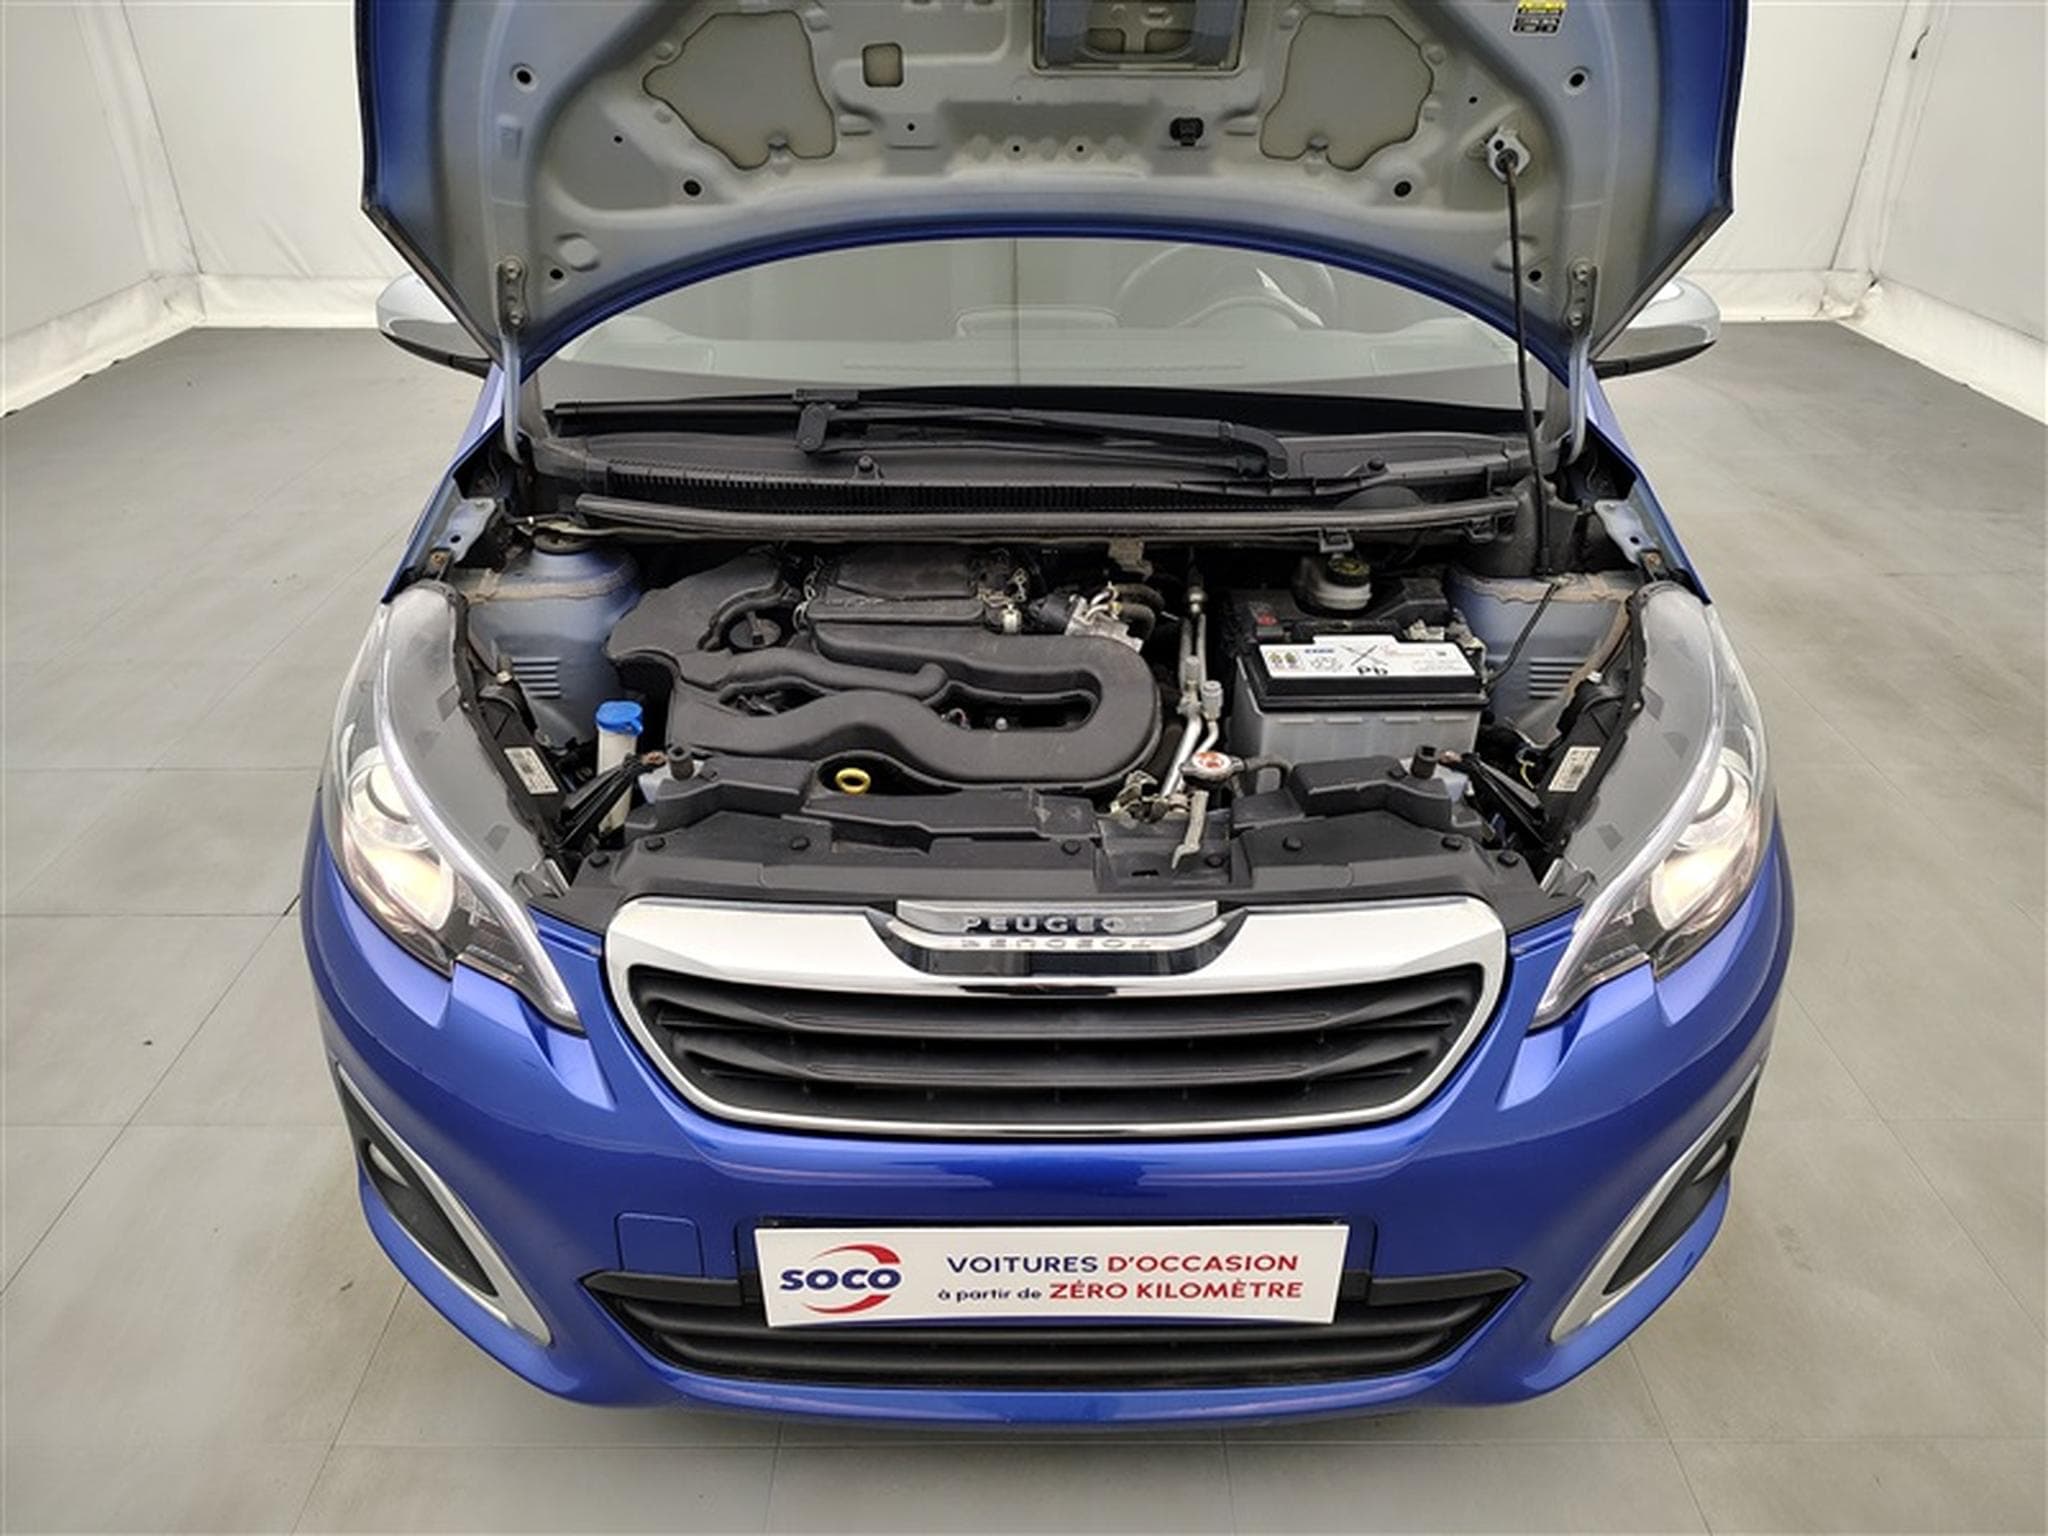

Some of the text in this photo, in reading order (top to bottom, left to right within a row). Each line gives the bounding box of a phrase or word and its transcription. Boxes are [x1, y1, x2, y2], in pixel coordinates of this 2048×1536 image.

[963, 914, 1153, 934] PEUGEOT
[947, 1255, 1298, 1274] VOITURES D'OCCASION
[779, 1268, 902, 1291] SOCO
[938, 1278, 1304, 1302] à partir de ZÉRO KILOMÈTRE
